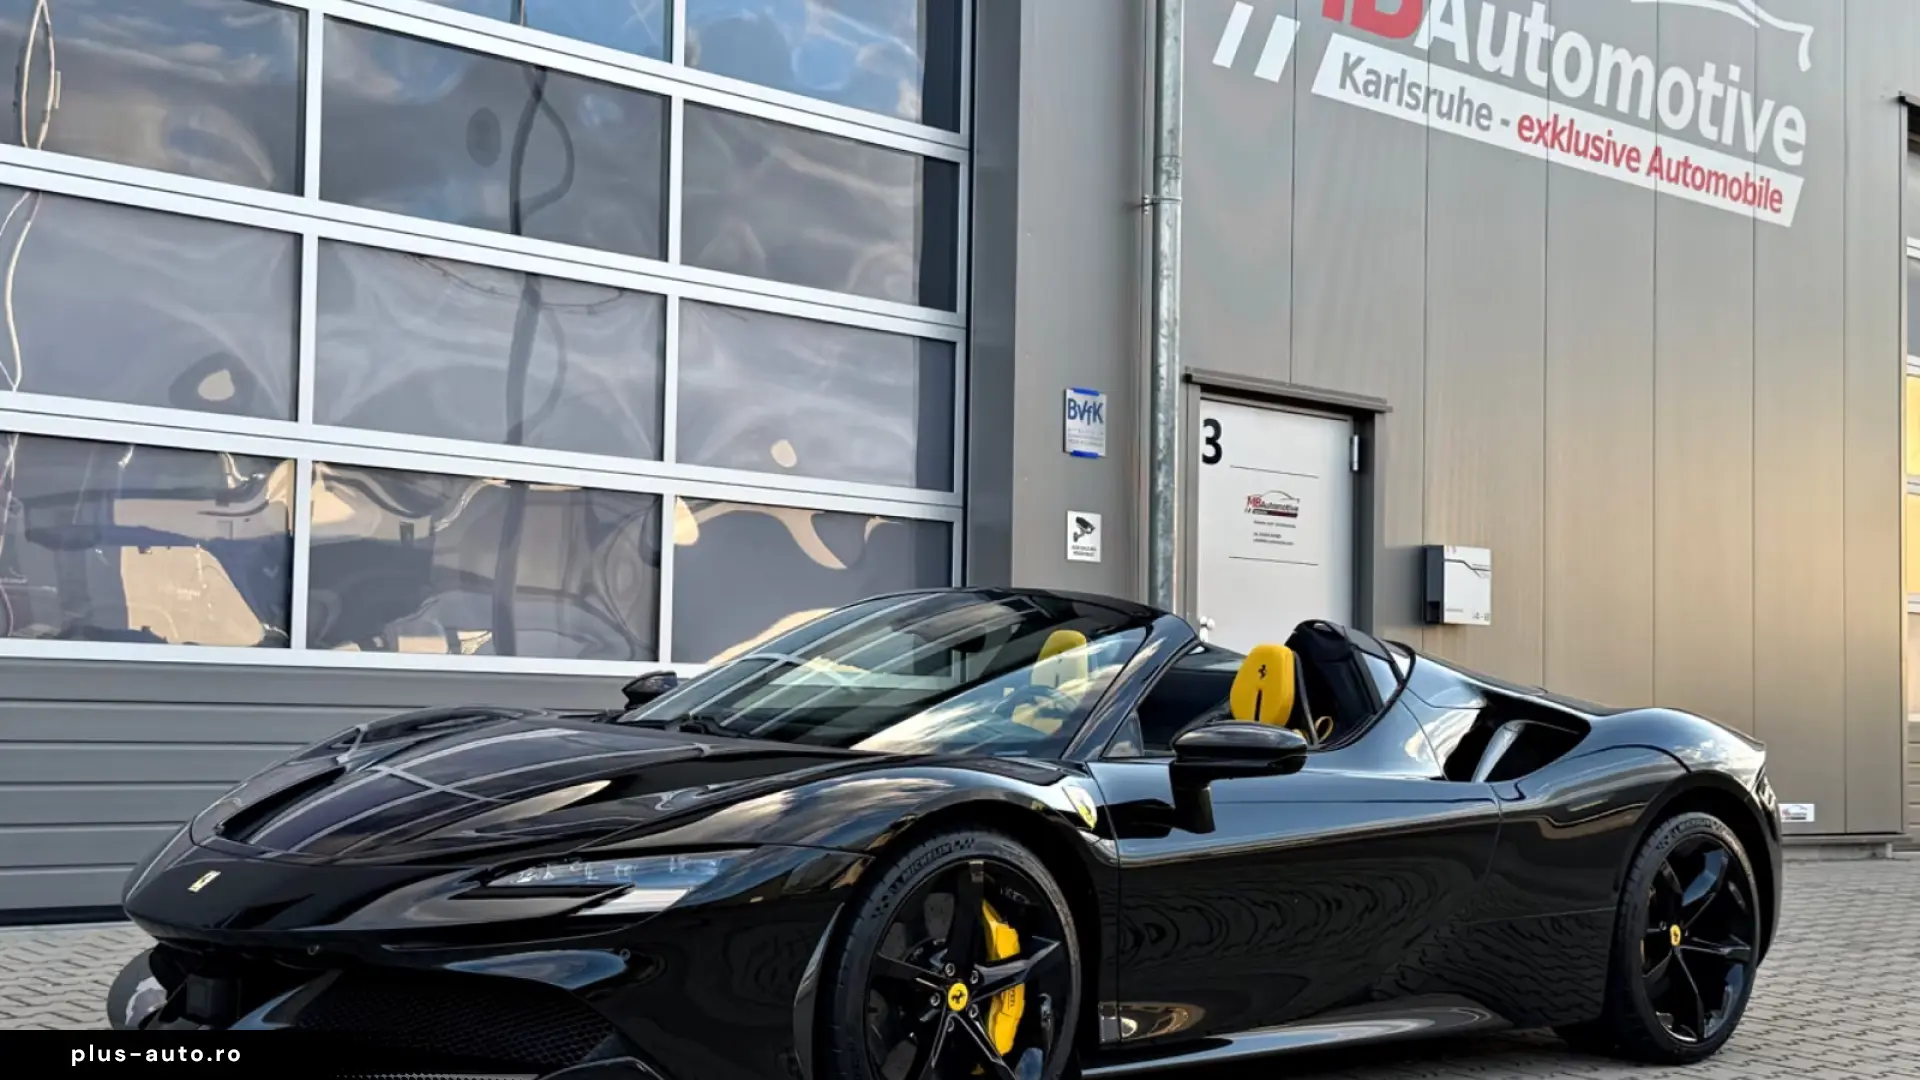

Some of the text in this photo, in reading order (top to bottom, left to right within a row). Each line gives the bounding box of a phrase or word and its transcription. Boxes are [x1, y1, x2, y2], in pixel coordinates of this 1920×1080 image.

[1339, 52, 1493, 131] Karlsruhe
[1517, 113, 1641, 173] exklusive
[1646, 146, 1783, 213] Automobile
[1068, 398, 1104, 425] BVfK
[1202, 418, 1223, 465] 3
